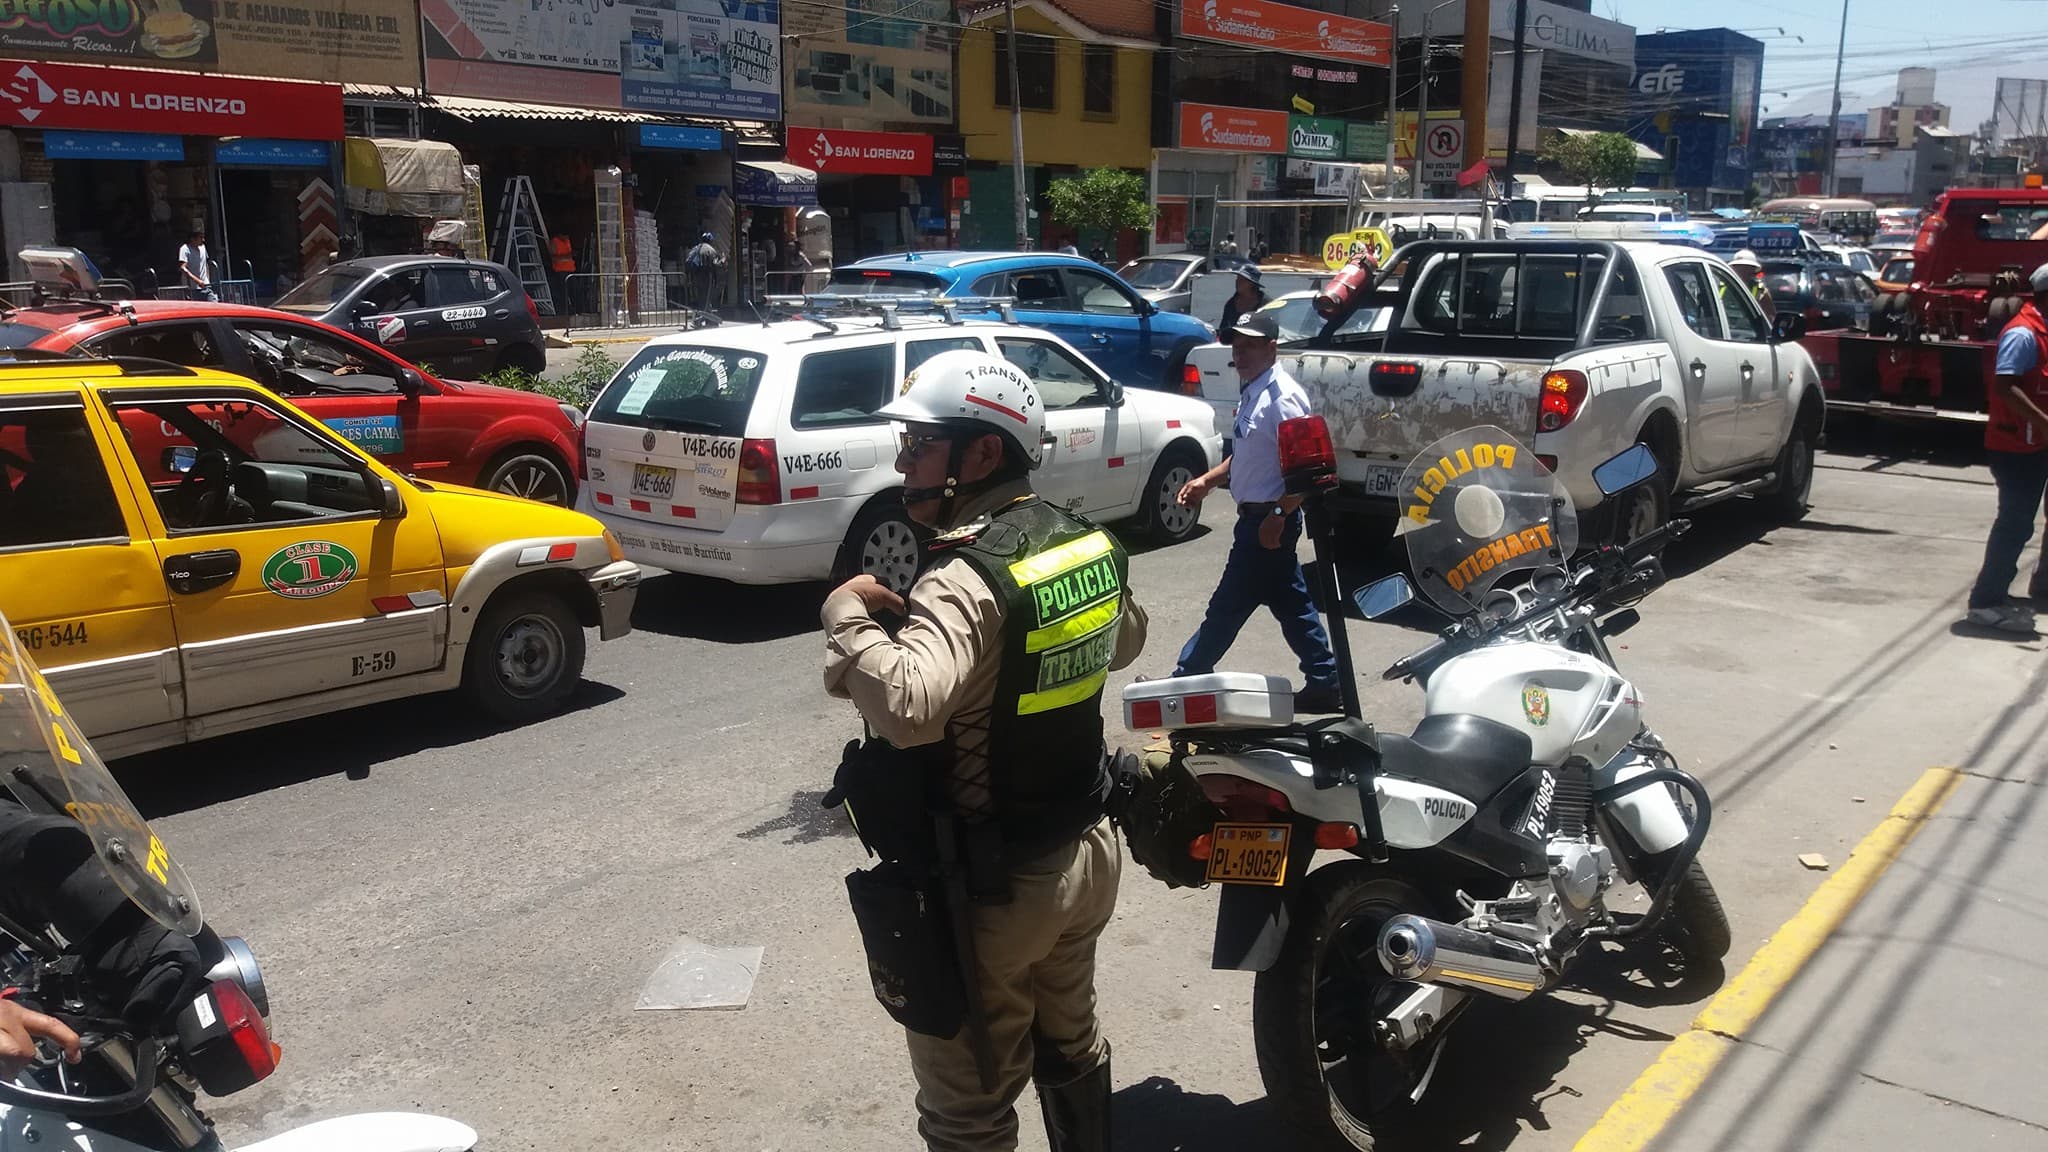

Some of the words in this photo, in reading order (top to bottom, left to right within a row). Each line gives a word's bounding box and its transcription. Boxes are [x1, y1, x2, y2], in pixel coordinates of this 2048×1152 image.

[315, 10, 372, 32] VALENCIA
[1535, 14, 1610, 56] CELIMA
[727, 42, 778, 71] PEGAMENTOS
[736, 60, 773, 85] FRAGUAS
[63, 88, 120, 108] SAN
[130, 94, 247, 116] LORENZO
[1212, 128, 1271, 147] Sudamericano
[835, 146, 860, 158] SAN
[864, 148, 915, 160] LORENZO
[445, 310, 484, 320] 22-4444
[965, 365, 1035, 407] TRANSITO
[364, 426, 401, 440] CAYMA
[682, 437, 736, 460] V4E-666
[783, 450, 842, 475] V4E-666
[633, 471, 672, 494] V4E-666
[285, 543, 331, 559] CLASE
[293, 555, 331, 584] 1
[1037, 560, 1117, 619] POLICIA
[351, 650, 396, 677] E-59
[1424, 798, 1467, 821] POLICIA
[1527, 769, 1557, 840] PL-19052
[1240, 831, 1262, 841] PNP
[1212, 848, 1282, 878] PL-19052
